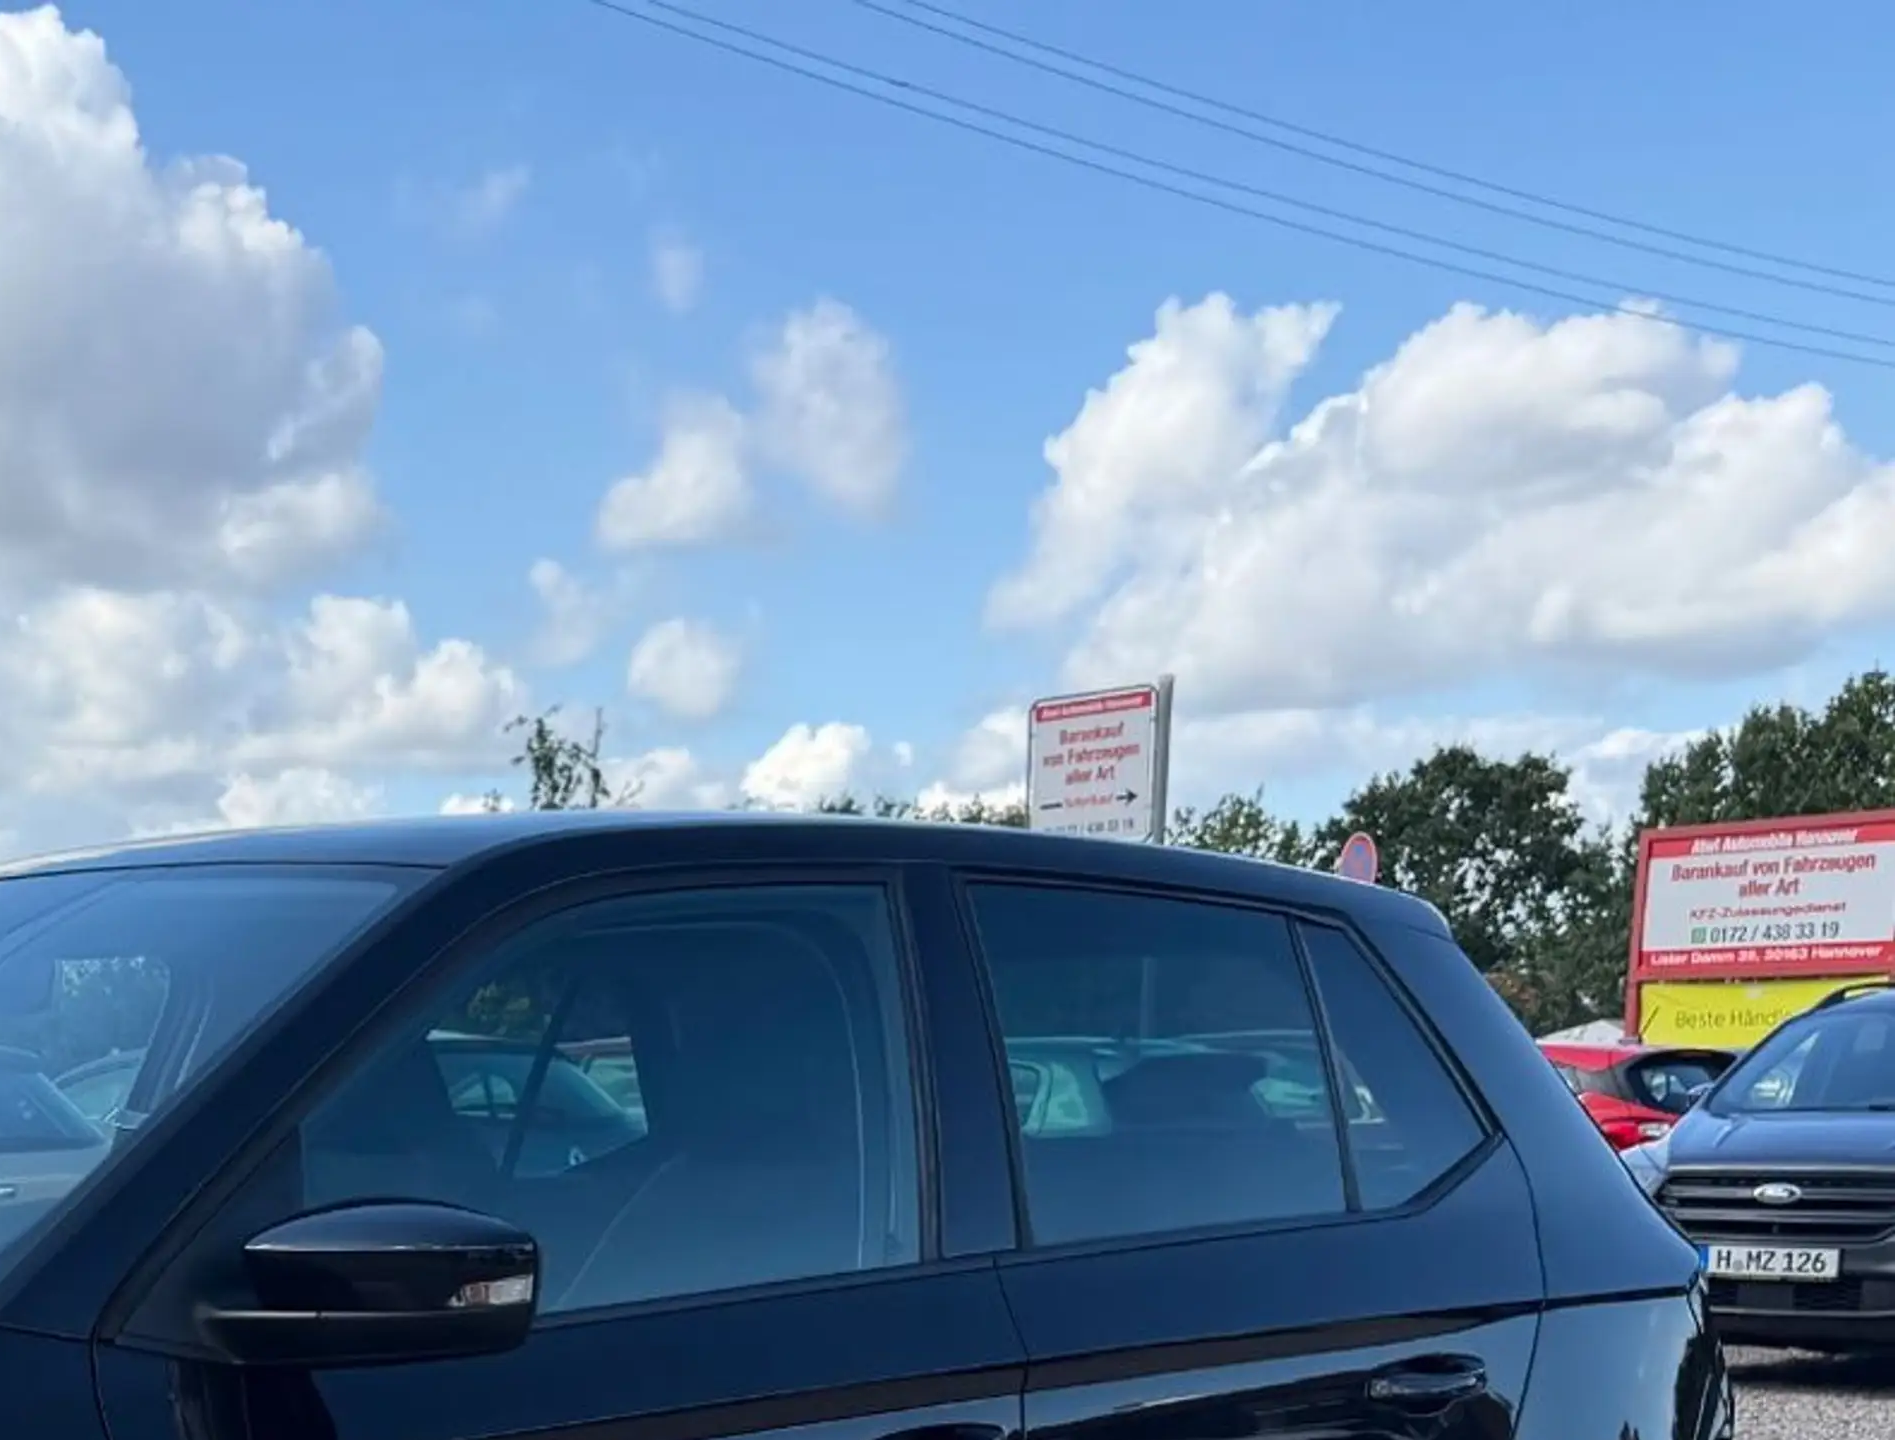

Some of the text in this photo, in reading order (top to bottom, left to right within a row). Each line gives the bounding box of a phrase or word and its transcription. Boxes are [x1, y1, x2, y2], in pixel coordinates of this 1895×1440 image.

[1096, 766, 1115, 781] Art
[1671, 853, 1876, 882] Barankauf von Fahrzeugen
[1739, 878, 1800, 897] aller Art
[1710, 926, 1748, 943] 0172
[1763, 924, 1792, 941] 438
[1795, 922, 1815, 939] 33
[1821, 921, 1840, 938] 19
[1811, 945, 1882, 960] Hannover
[1675, 1010, 1733, 1029] Beste
[1716, 1250, 1827, 1273] H MZ 126
